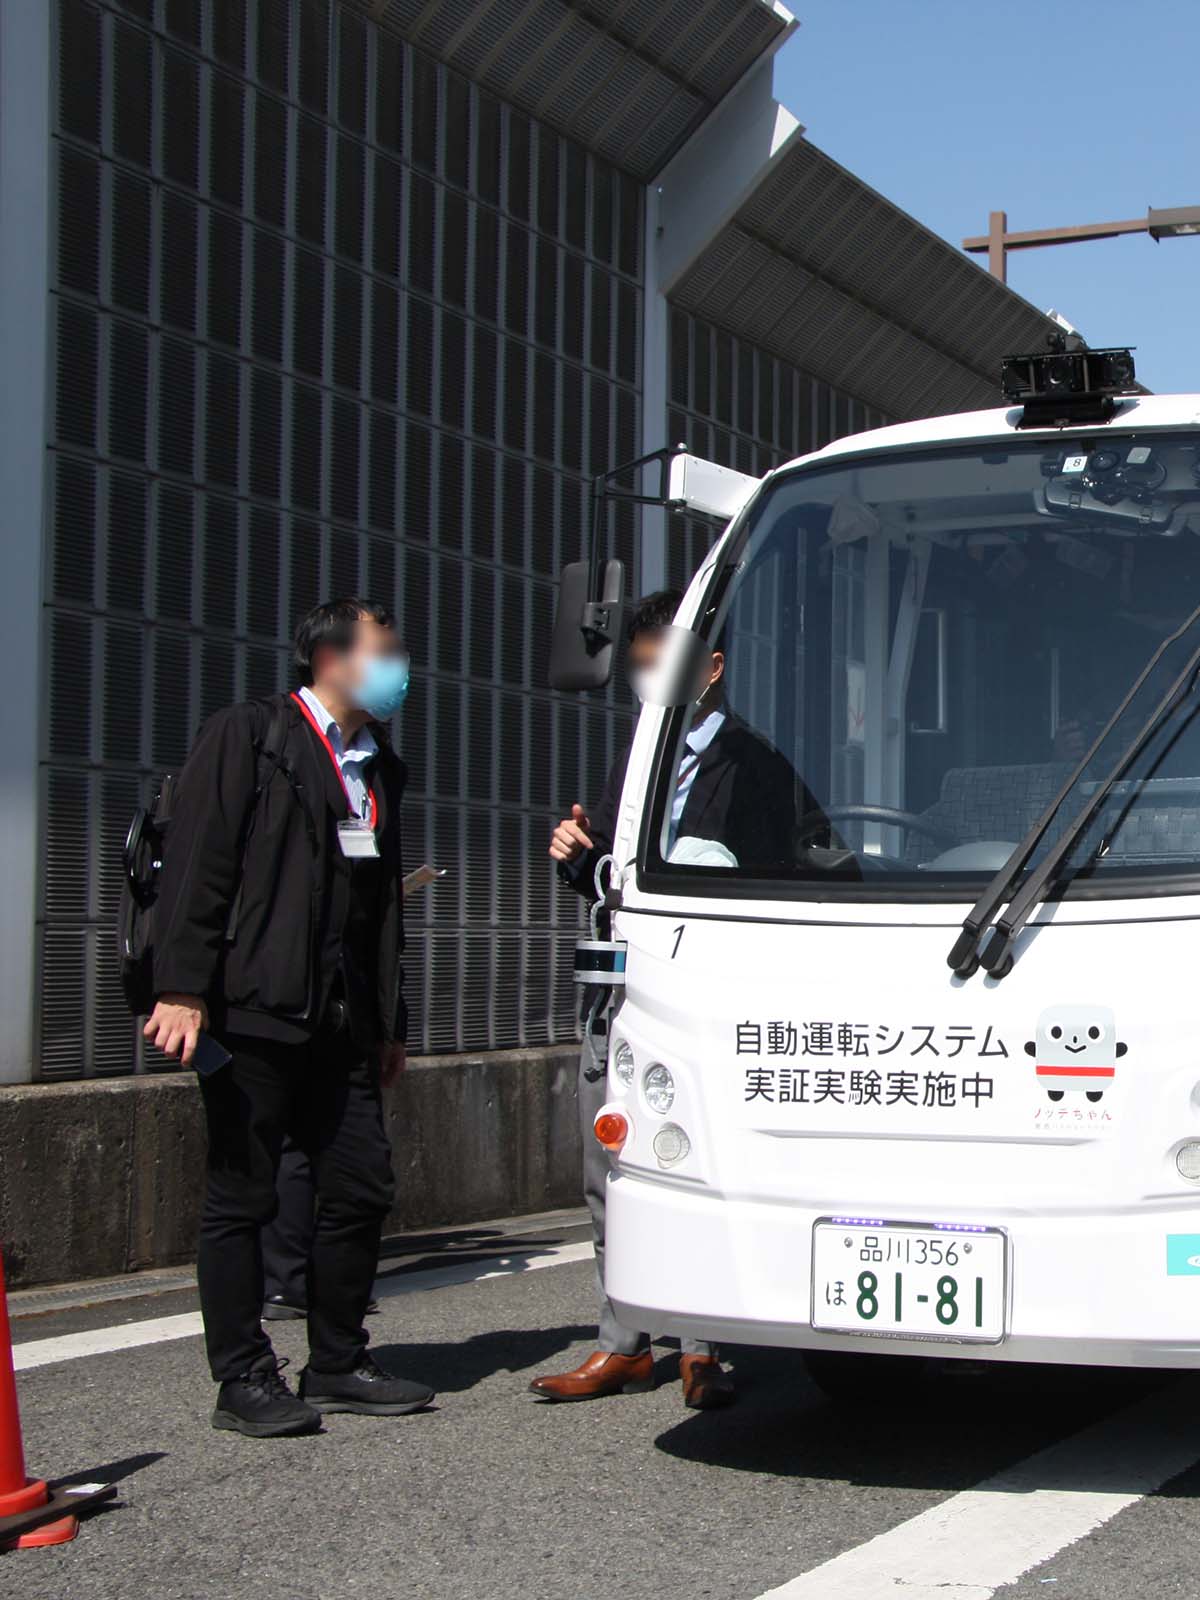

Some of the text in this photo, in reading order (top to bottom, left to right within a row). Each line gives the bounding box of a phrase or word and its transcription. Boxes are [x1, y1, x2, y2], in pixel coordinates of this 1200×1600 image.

[671, 924, 686, 959] 1
[735, 1020, 1010, 1059] 自動運転システム
[744, 1067, 995, 1109] 実証実験実施中
[825, 1270, 984, 1328] ほ 81-81
